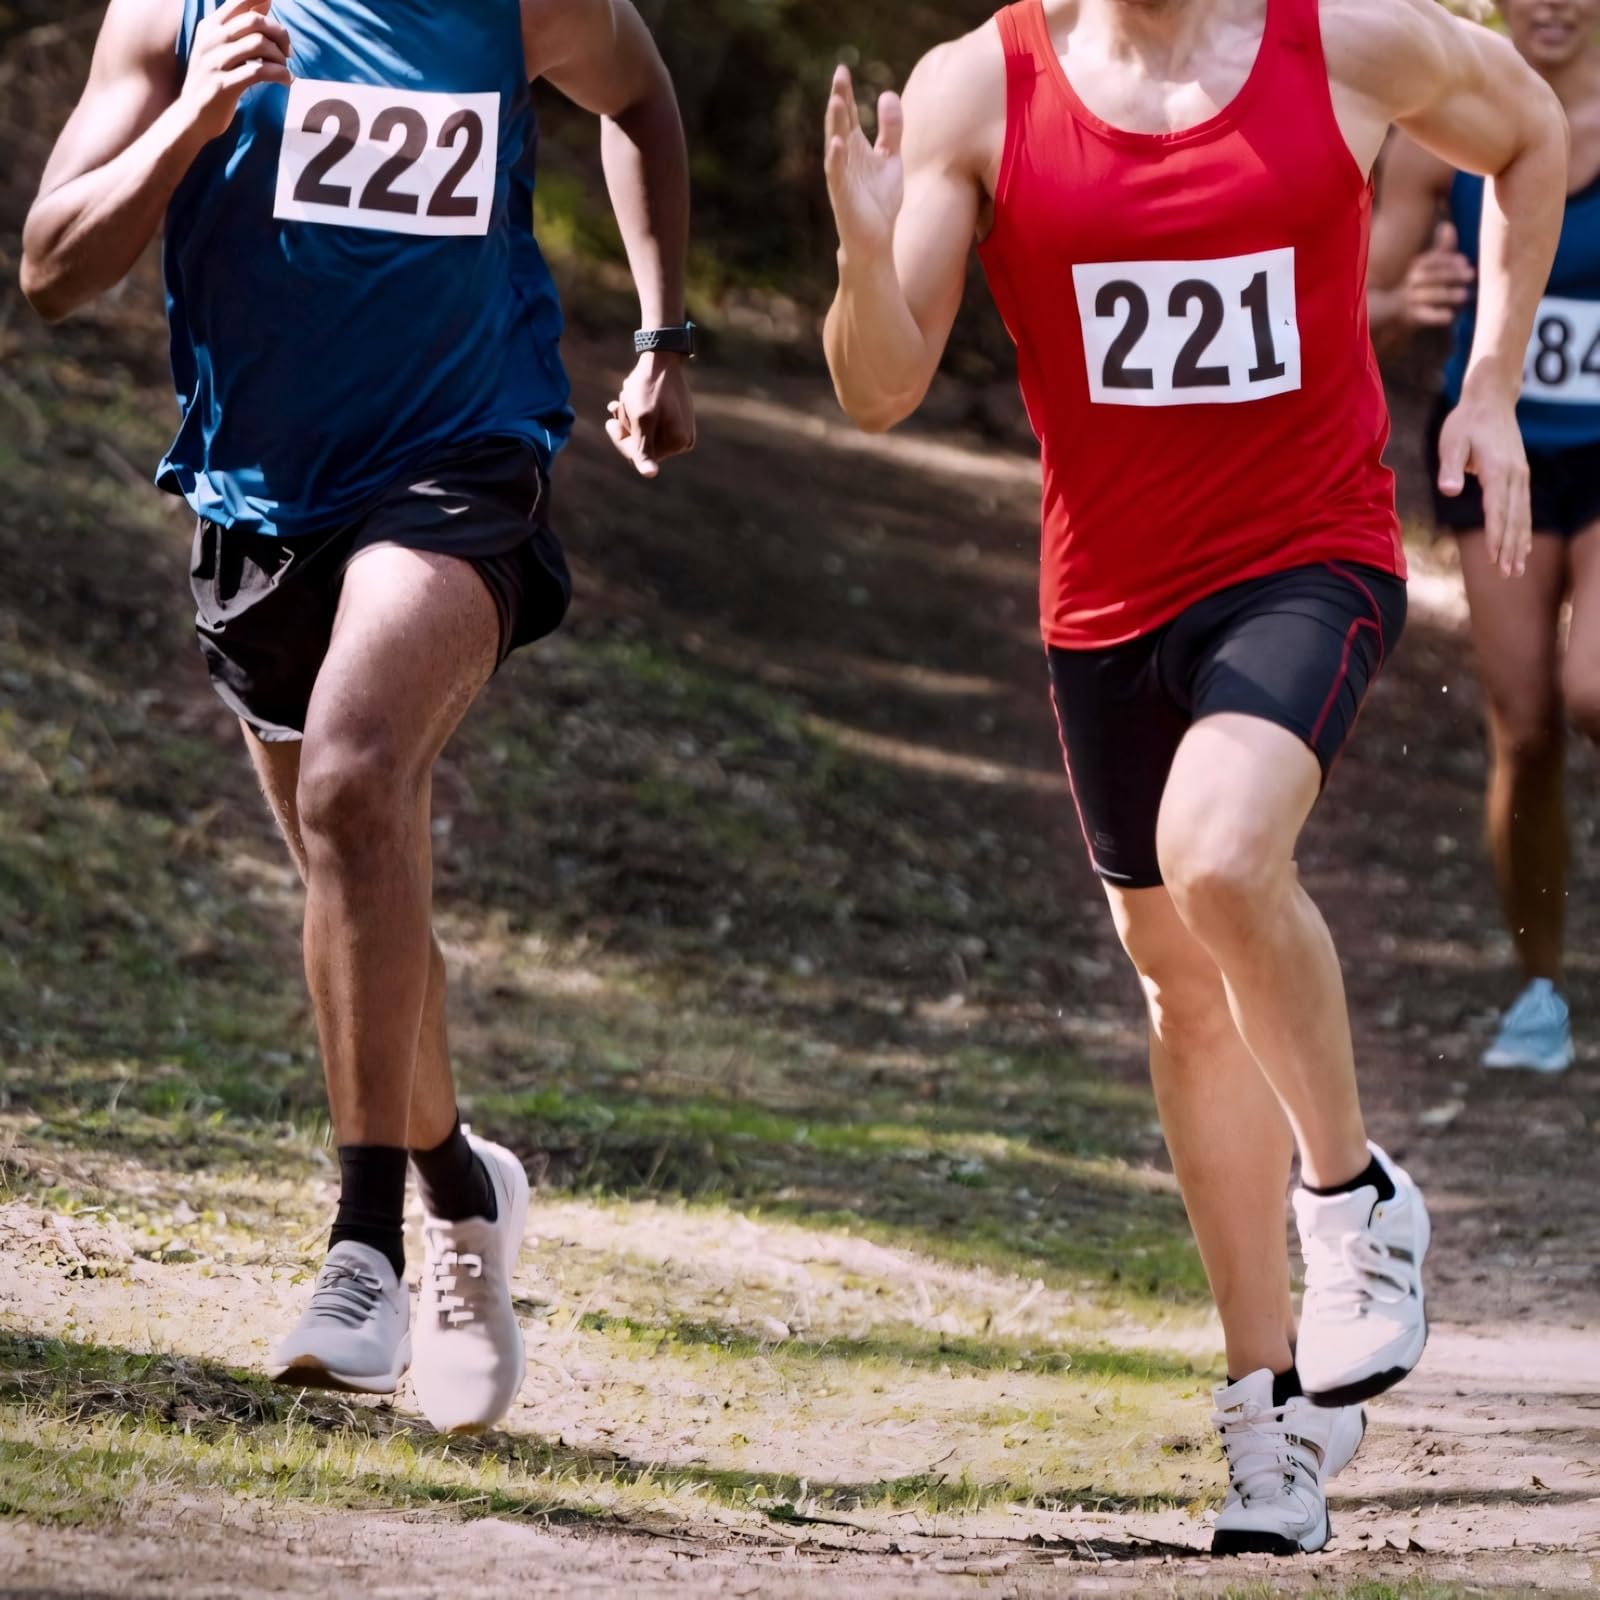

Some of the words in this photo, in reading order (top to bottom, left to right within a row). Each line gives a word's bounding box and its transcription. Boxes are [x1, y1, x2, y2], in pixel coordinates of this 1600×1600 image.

[293, 98, 483, 217] 222
[1095, 270, 1286, 389] 221
[1522, 316, 1600, 386] 84
